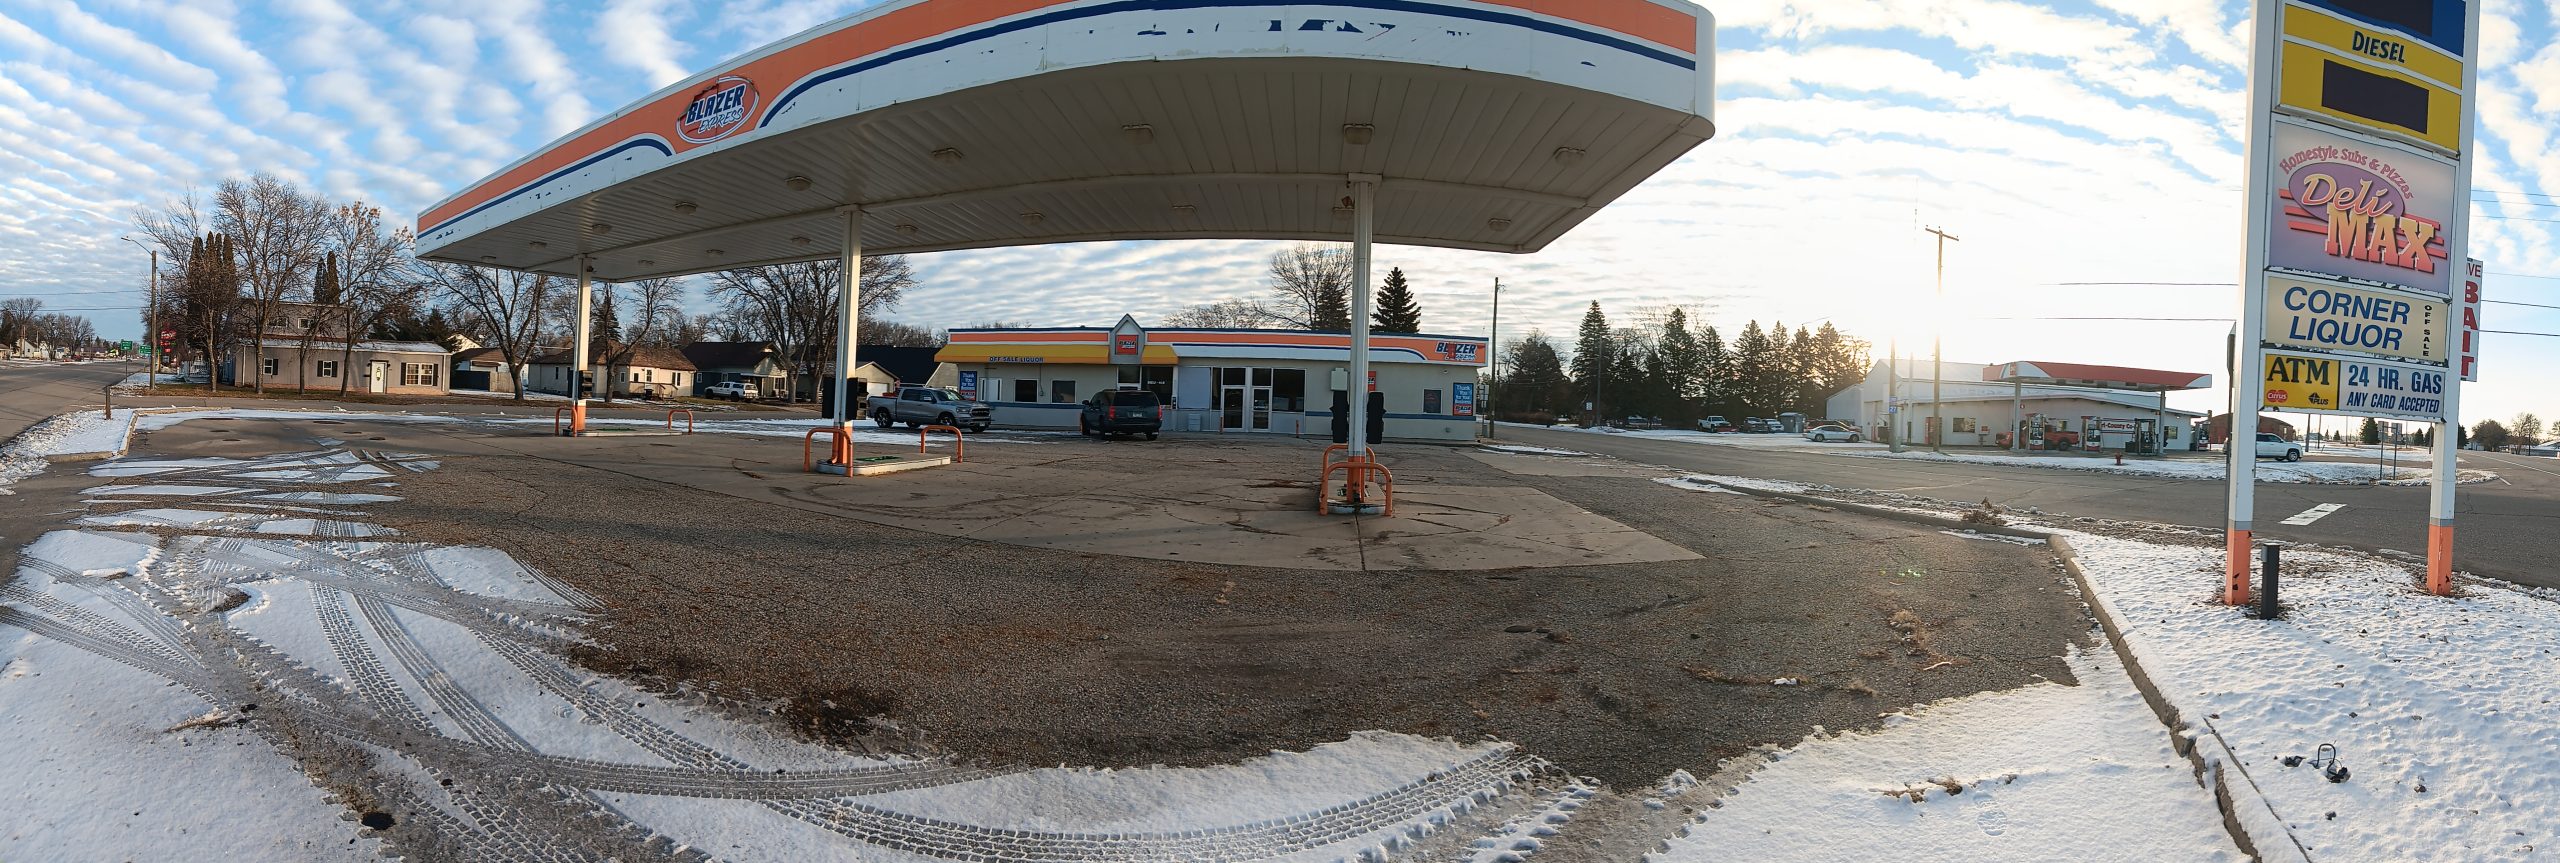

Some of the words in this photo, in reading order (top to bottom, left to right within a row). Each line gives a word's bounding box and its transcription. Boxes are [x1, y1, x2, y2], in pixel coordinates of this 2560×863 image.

[2352, 30, 2405, 63] DIESEL
[687, 84, 746, 123] BLAZER
[699, 107, 744, 132] EXPRESS
[2279, 145, 2339, 175] Homestyle
[2341, 148, 2368, 165] Subs
[2368, 158, 2381, 171] &
[2301, 173, 2394, 217] Deli
[2324, 201, 2435, 274] MAX
[2284, 286, 2411, 325] CORNER
[2424, 305, 2433, 325] OFF
[1436, 342, 1477, 354] BLZER
[2289, 316, 2403, 351] LIQUOR
[2423, 329, 2431, 357] SALE
[2267, 357, 2330, 385] ATM
[2348, 365, 2369, 387] 24
[2378, 367, 2404, 391] HR.
[2411, 371, 2442, 395] GAS
[2346, 391, 2369, 407] ANY
[2370, 394, 2395, 410] CARD
[2398, 396, 2440, 413] ACCEPTED
